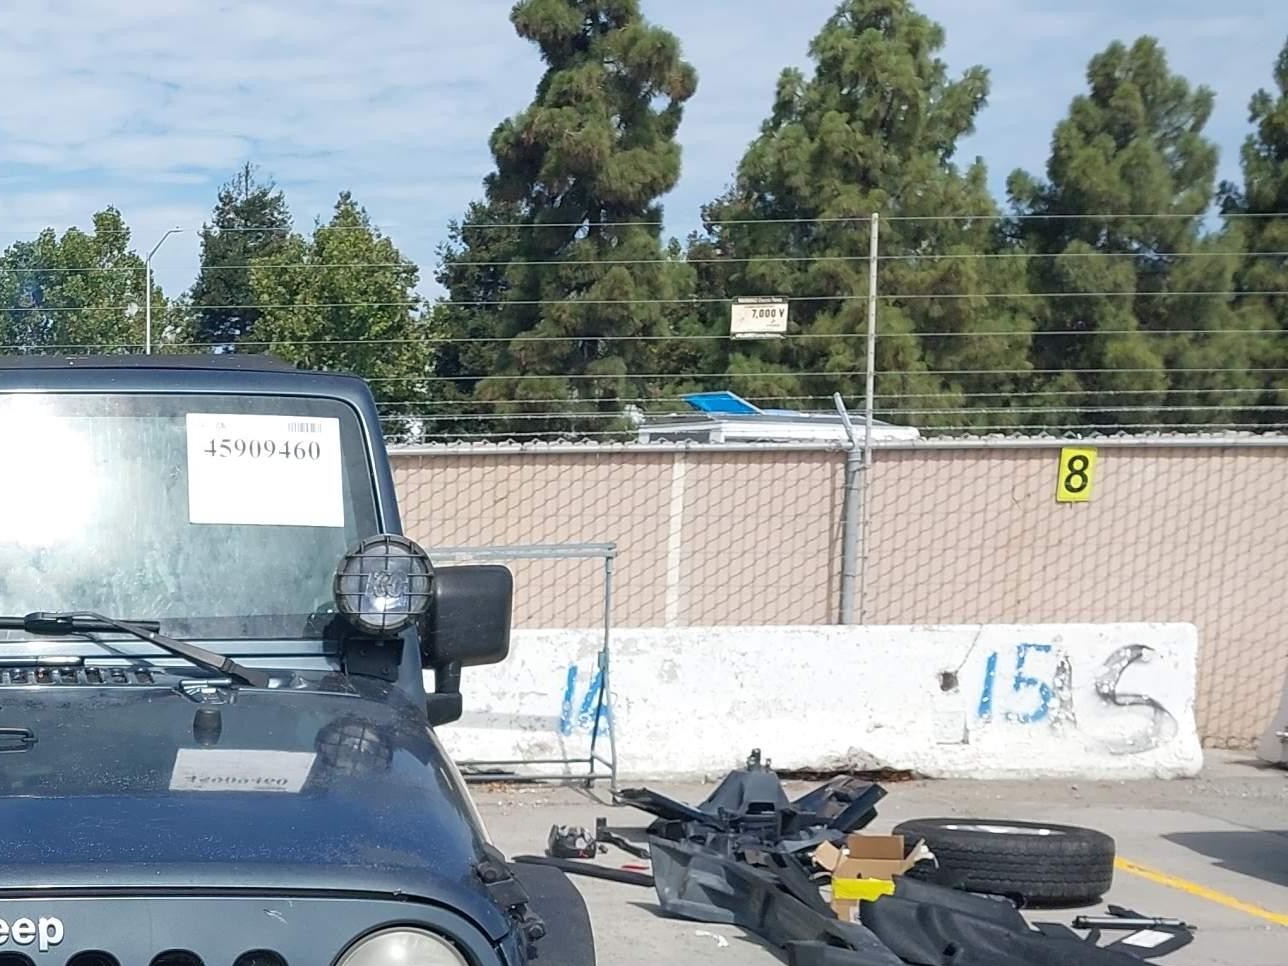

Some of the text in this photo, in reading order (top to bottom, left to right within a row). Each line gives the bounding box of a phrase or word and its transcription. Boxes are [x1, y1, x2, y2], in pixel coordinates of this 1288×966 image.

[778, 308, 785, 318] V
[204, 438, 321, 461] 45909460
[1064, 454, 1089, 493] 8
[978, 643, 1053, 722] 15
